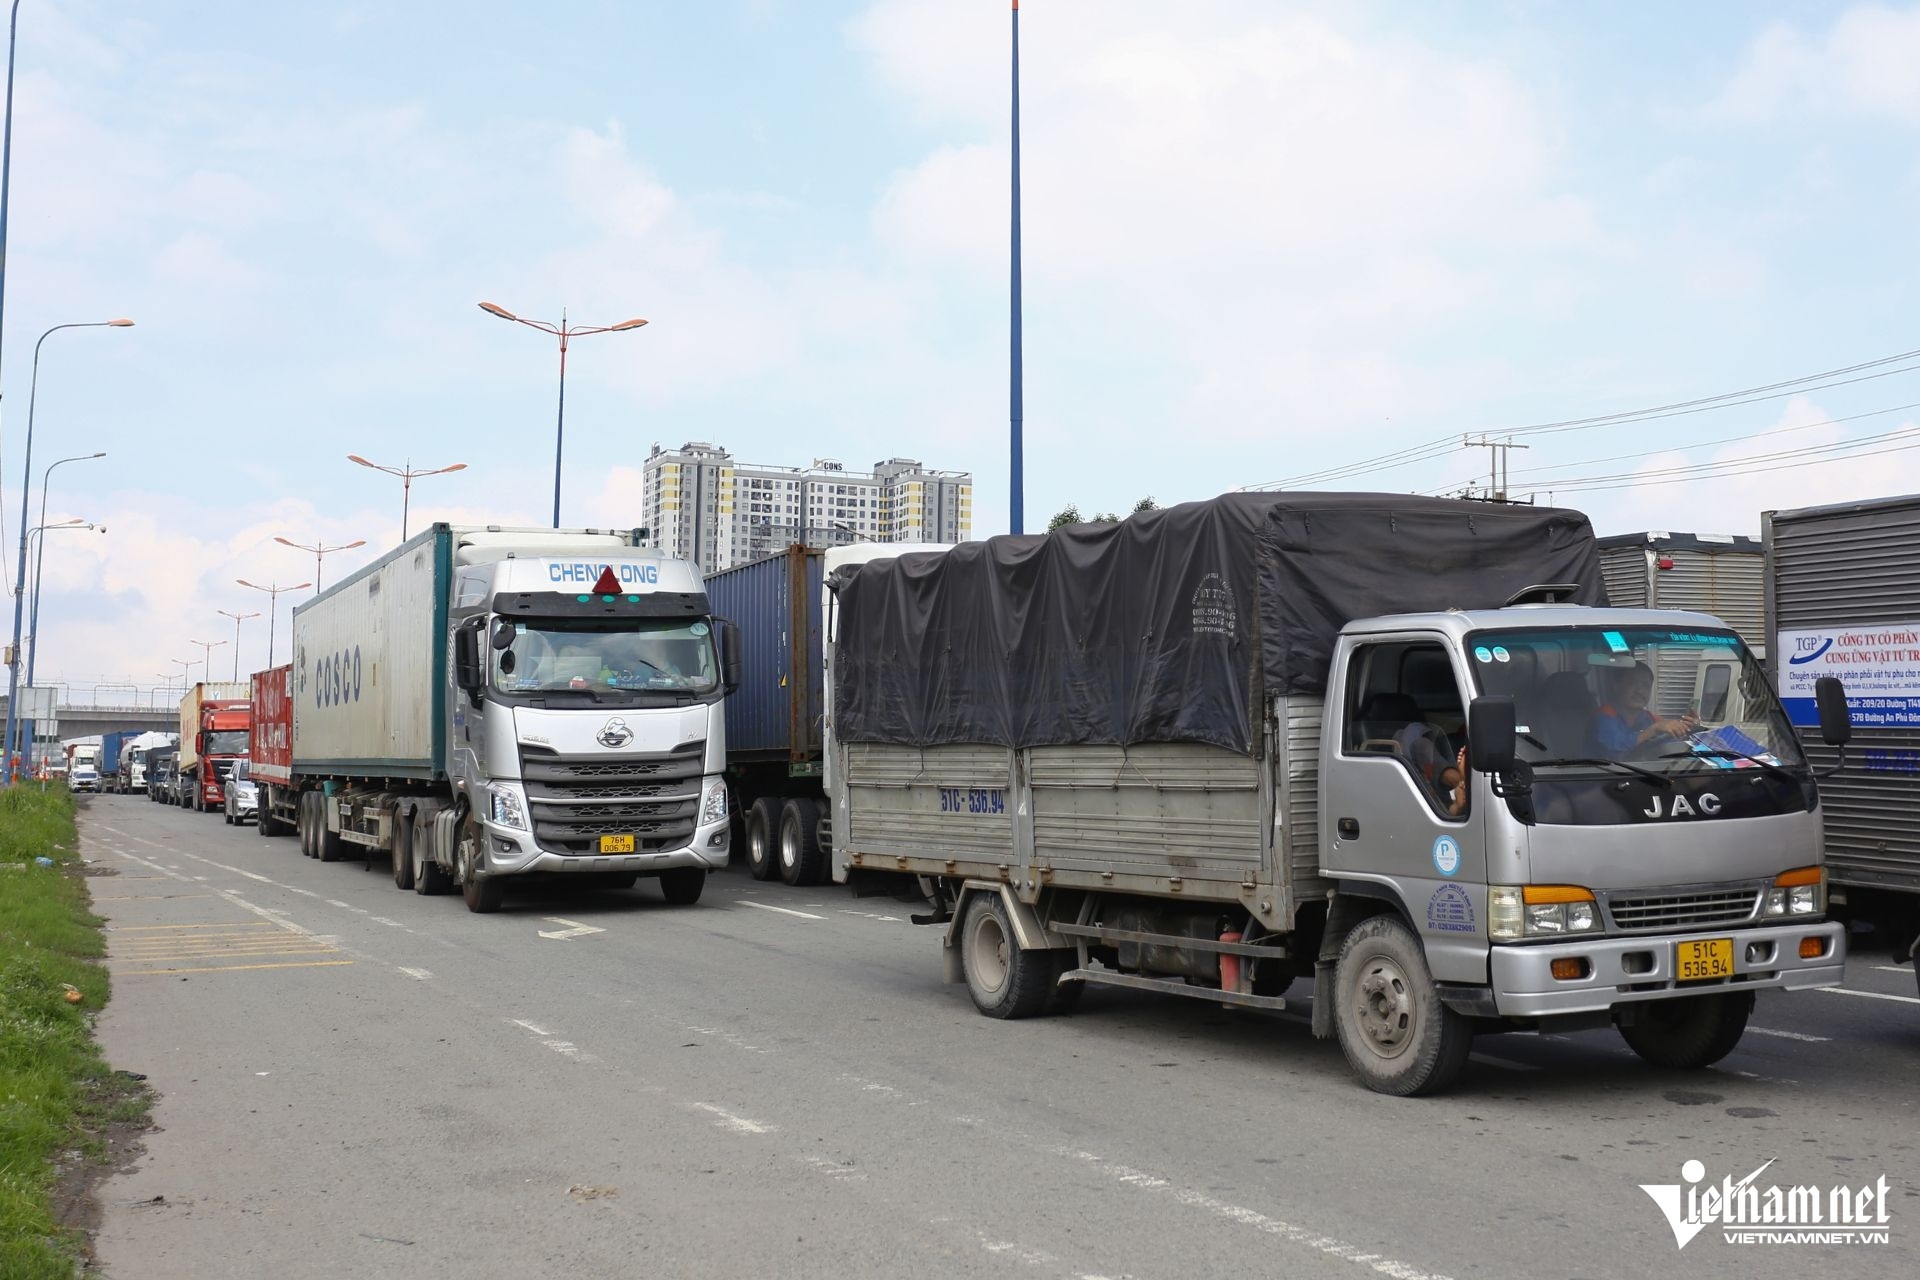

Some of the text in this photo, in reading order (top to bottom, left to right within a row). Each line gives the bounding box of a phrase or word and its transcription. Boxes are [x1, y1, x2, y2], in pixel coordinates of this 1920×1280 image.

[823, 461, 843, 471] CONS
[549, 563, 658, 584] CHENONG
[1795, 637, 1818, 651] TGP
[1838, 632, 1863, 647] CÔNG
[1864, 633, 1878, 646] TY
[1825, 651, 1850, 664] CUNG
[316, 644, 361, 709] COSCO
[1643, 793, 1721, 818] JAC
[610, 836, 625, 844] 76H
[1693, 941, 1717, 958] 51C
[1684, 958, 1727, 977] 536.94
